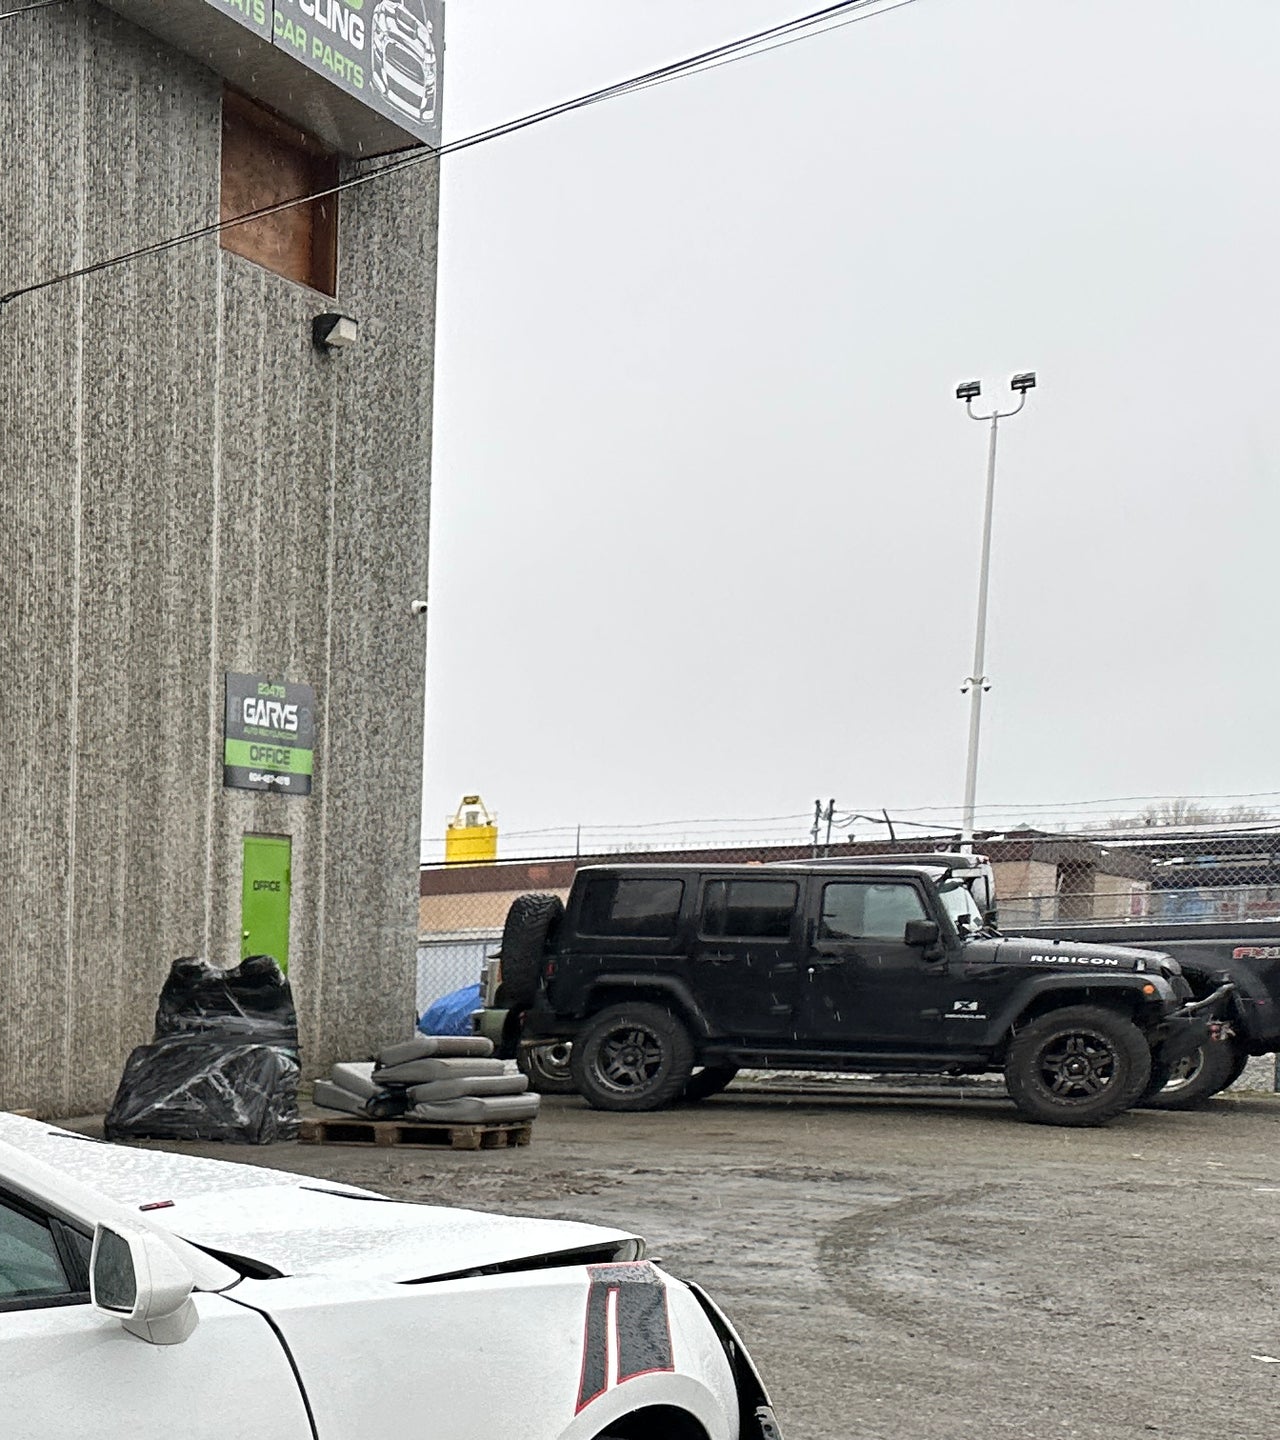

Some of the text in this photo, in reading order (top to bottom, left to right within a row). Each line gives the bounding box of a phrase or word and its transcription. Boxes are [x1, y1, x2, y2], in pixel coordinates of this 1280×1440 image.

[273, 10, 307, 53] CAR
[312, 36, 365, 89] PARTS
[243, 697, 298, 731] GARYS
[250, 745, 290, 765] OFFICE
[1030, 954, 1119, 966] RUBICON
